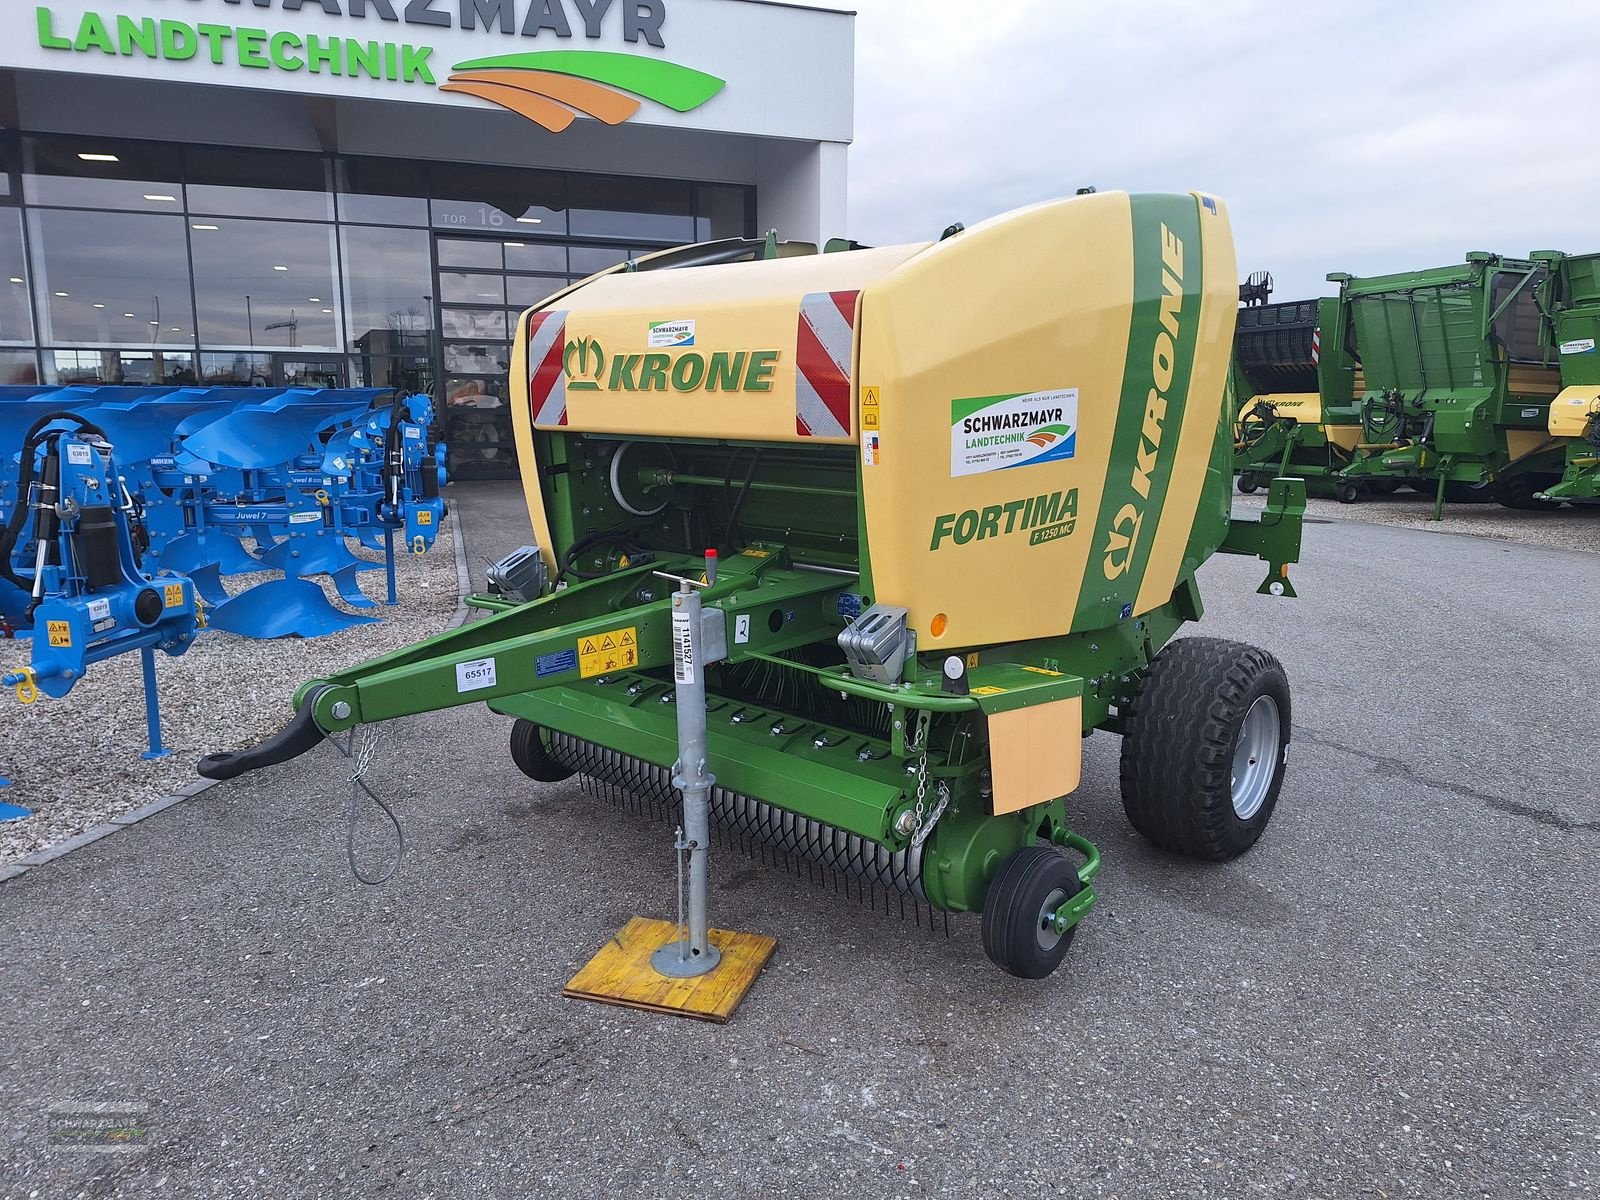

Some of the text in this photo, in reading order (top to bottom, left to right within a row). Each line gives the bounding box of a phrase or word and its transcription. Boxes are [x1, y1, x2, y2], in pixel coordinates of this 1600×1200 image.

[223, 0, 665, 49] ZMAYR
[36, 6, 437, 85] LANDTECHNIK
[442, 207, 504, 227] TOR 16
[607, 349, 781, 393] KRONE
[1130, 222, 1184, 501] KRONE
[963, 408, 1063, 434] SCHWARZMAYR
[965, 432, 1025, 449] LANDTECHNIK
[236, 511, 267, 520] Juwel 7
[930, 488, 1079, 551] FORTIMA
[1033, 523, 1074, 543] F 1250 MC
[739, 619, 747, 638] 2
[682, 627, 693, 665] 1141527
[465, 667, 492, 680] 65517
